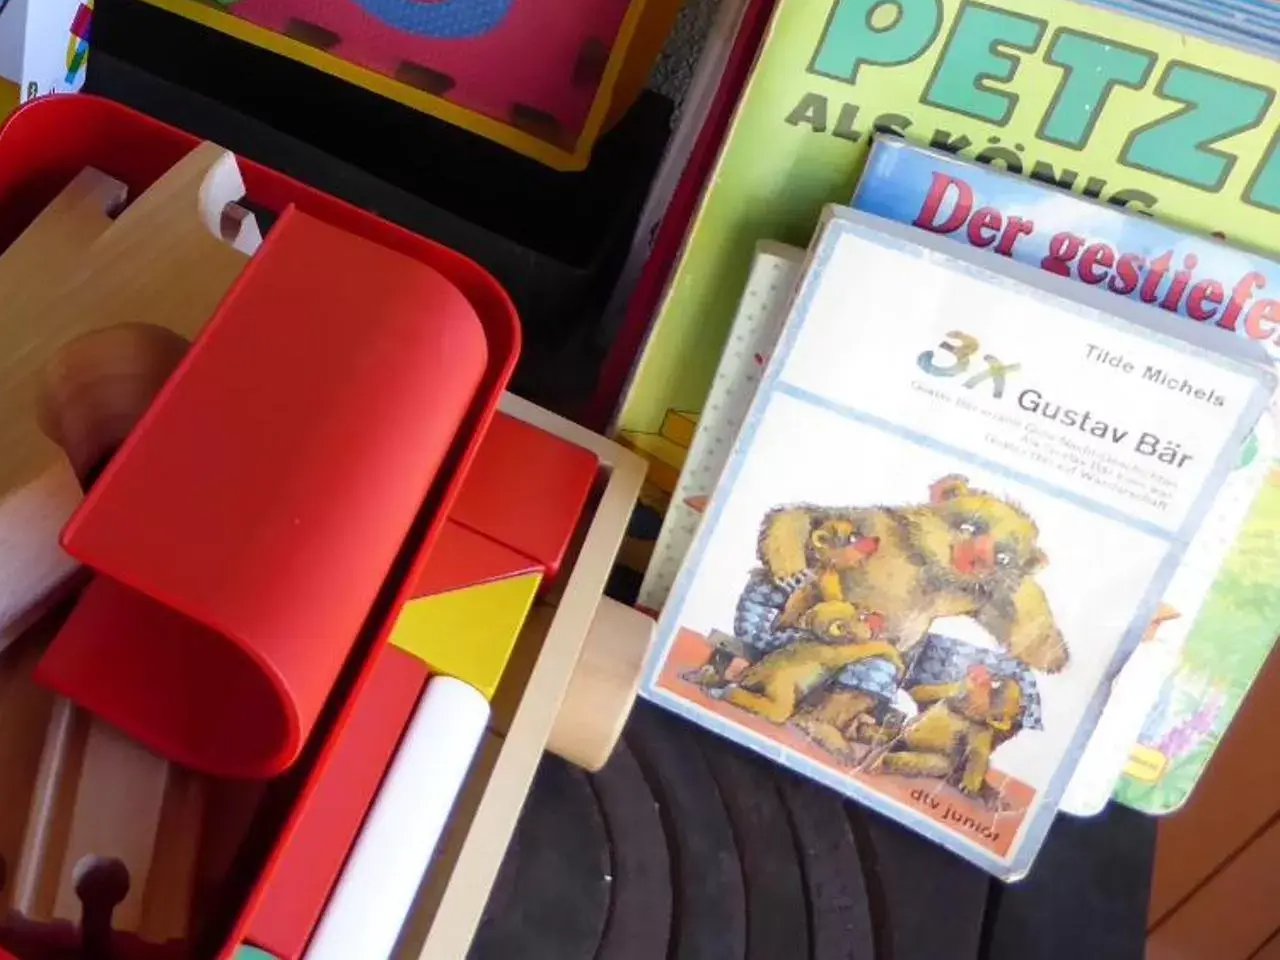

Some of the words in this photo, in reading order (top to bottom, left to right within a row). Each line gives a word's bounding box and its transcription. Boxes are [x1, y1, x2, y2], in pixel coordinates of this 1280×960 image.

[911, 171, 1034, 258] Der
[1040, 229, 1280, 350] gestiefe
[1085, 343, 1135, 375] Tilde
[1142, 365, 1226, 409] Michels
[1017, 388, 1129, 445] Gustav
[1134, 432, 1194, 470] Bär
[908, 787, 940, 811] dtv
[943, 806, 1001, 842] junior
